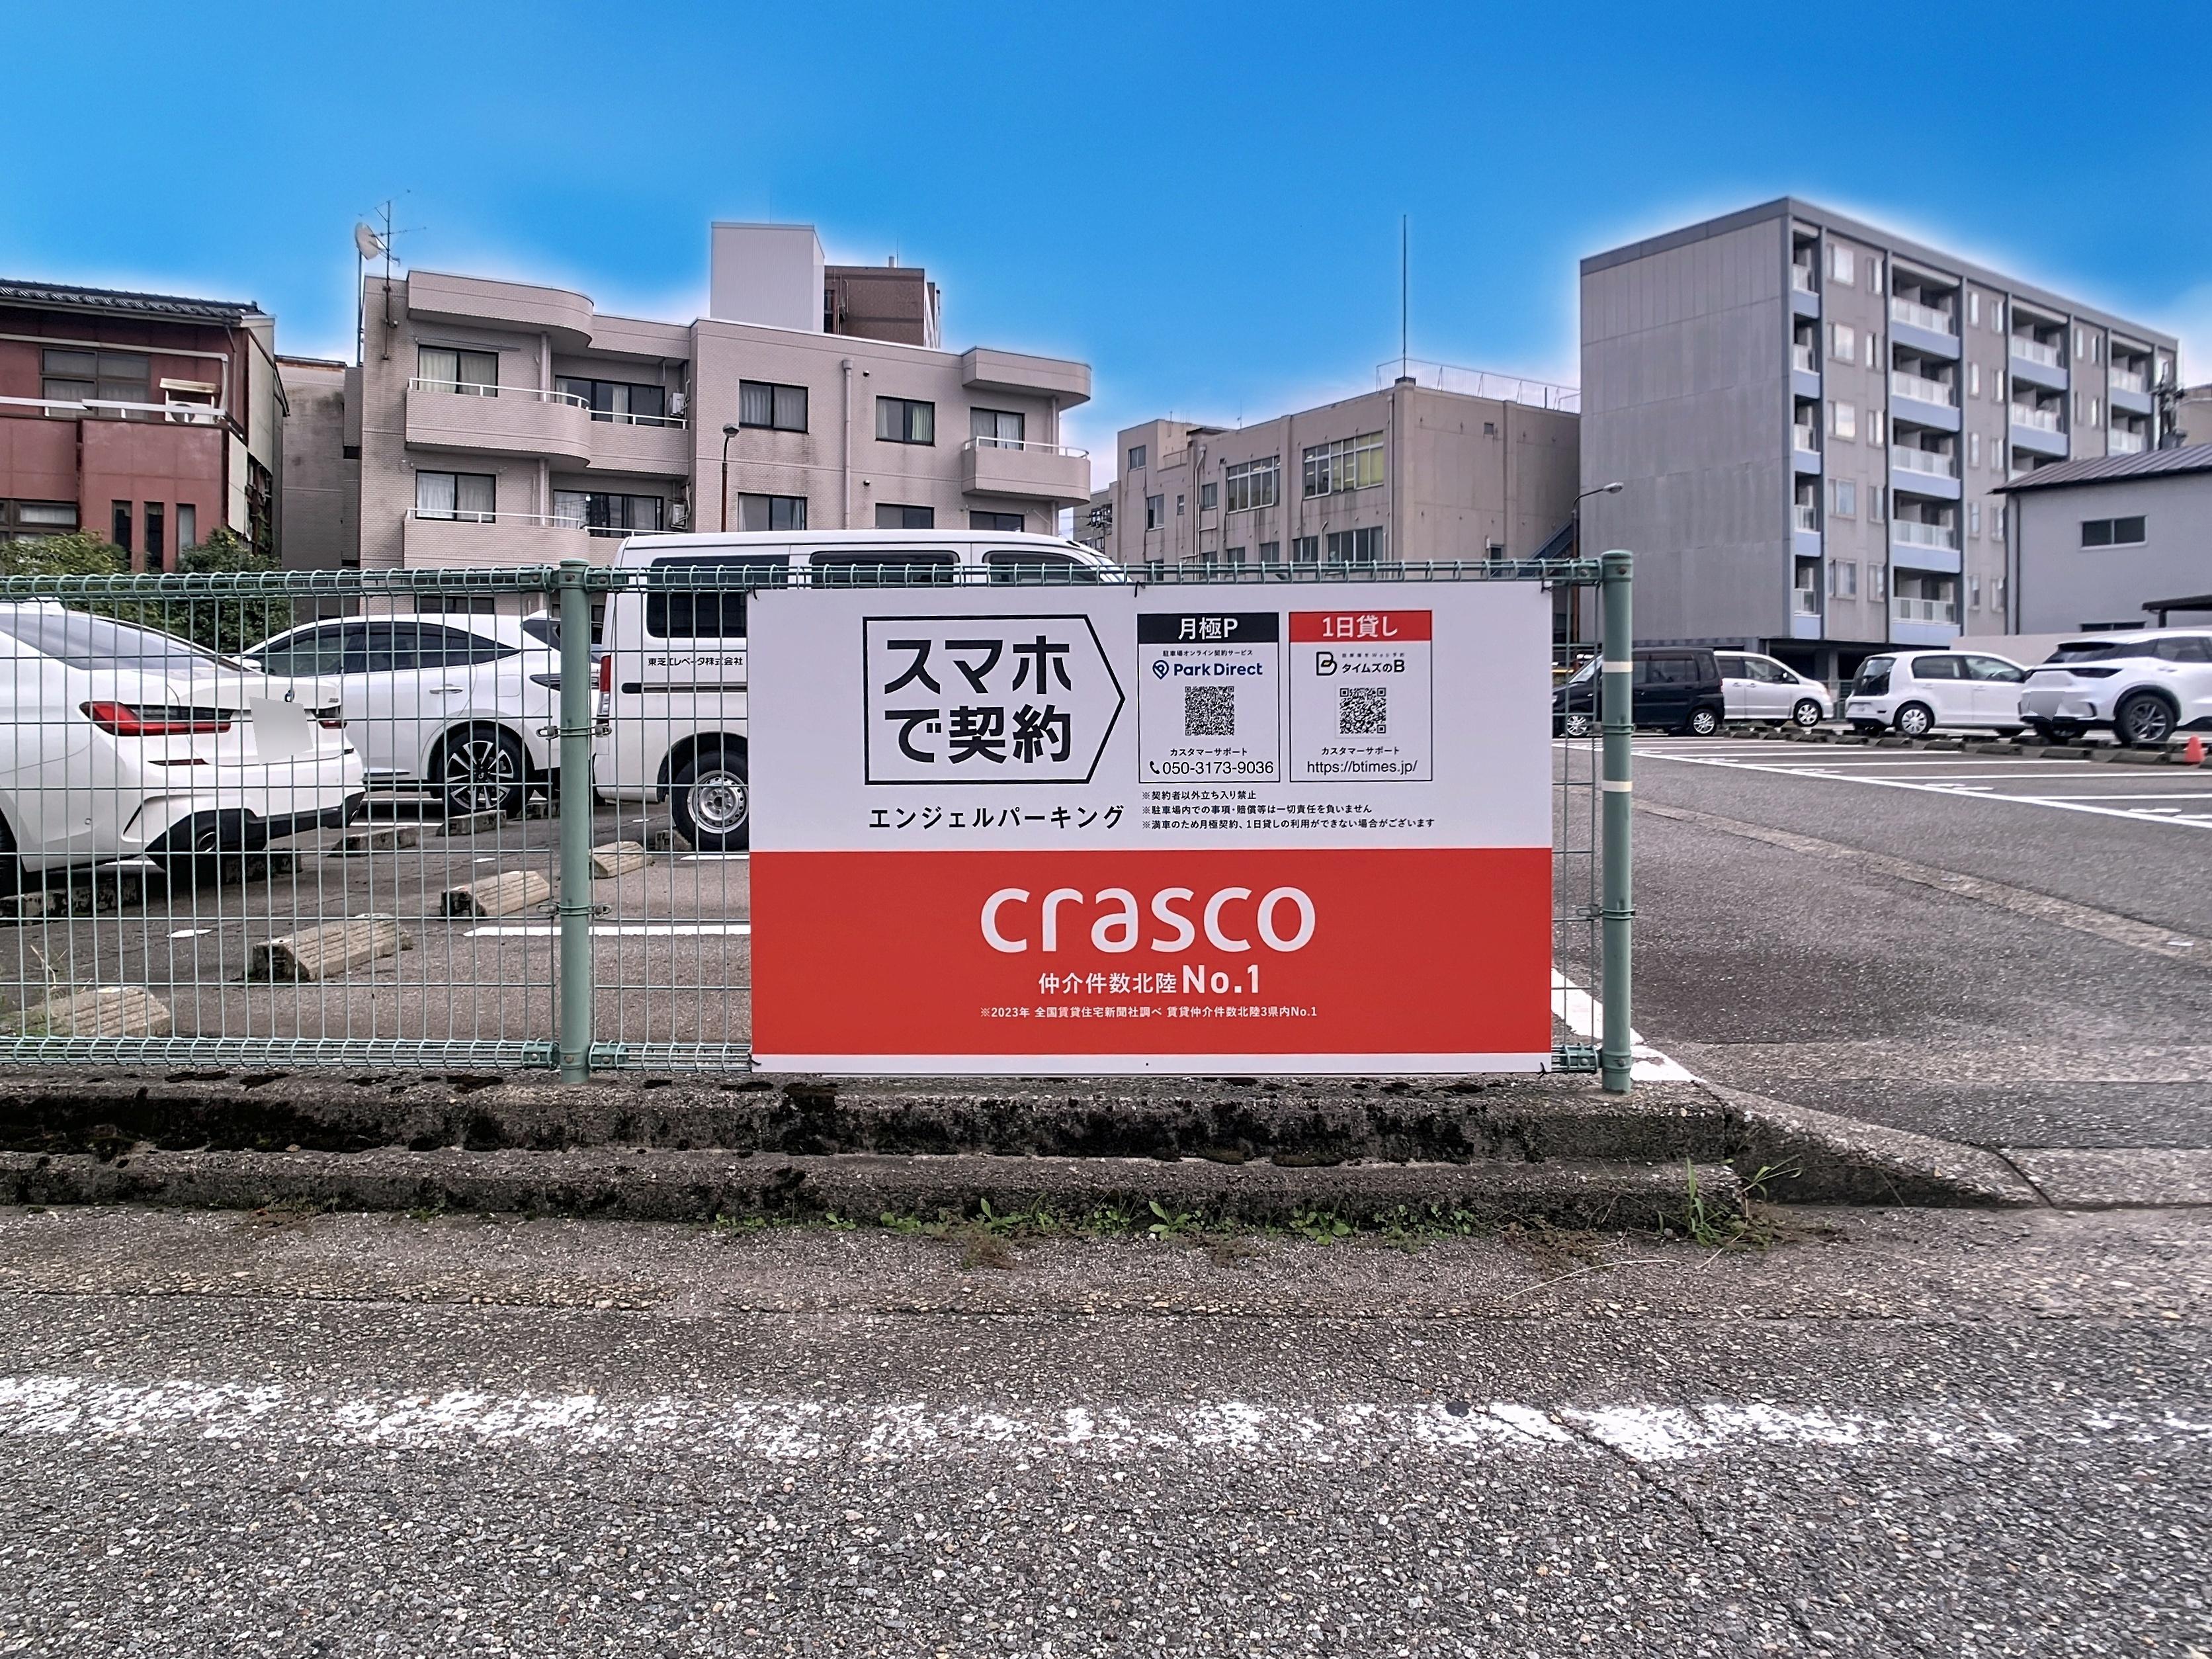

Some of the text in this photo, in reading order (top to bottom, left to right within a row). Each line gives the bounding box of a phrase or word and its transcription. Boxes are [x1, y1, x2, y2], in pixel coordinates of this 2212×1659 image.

[1178, 617, 1238, 640] 月極P
[1322, 615, 1398, 638] 1日貸し
[884, 635, 1072, 695] スマホ
[1173, 662, 1263, 676] Park Direct
[1341, 659, 1405, 673] タイムズのB
[884, 703, 1071, 765] で契約
[1170, 747, 1248, 757] カスタマーサポート
[1322, 745, 1400, 755] カスタマーサポート
[1162, 761, 1274, 775] 050-3173-9036
[1307, 760, 1418, 776] https://btimes.jp/
[1142, 790, 1257, 800] ※契約者以外立ち入り禁止
[869, 804, 1125, 830] エンジェルパーキング
[980, 886, 1316, 953] crasco
[980, 1006, 1029, 1018] ※2023年
